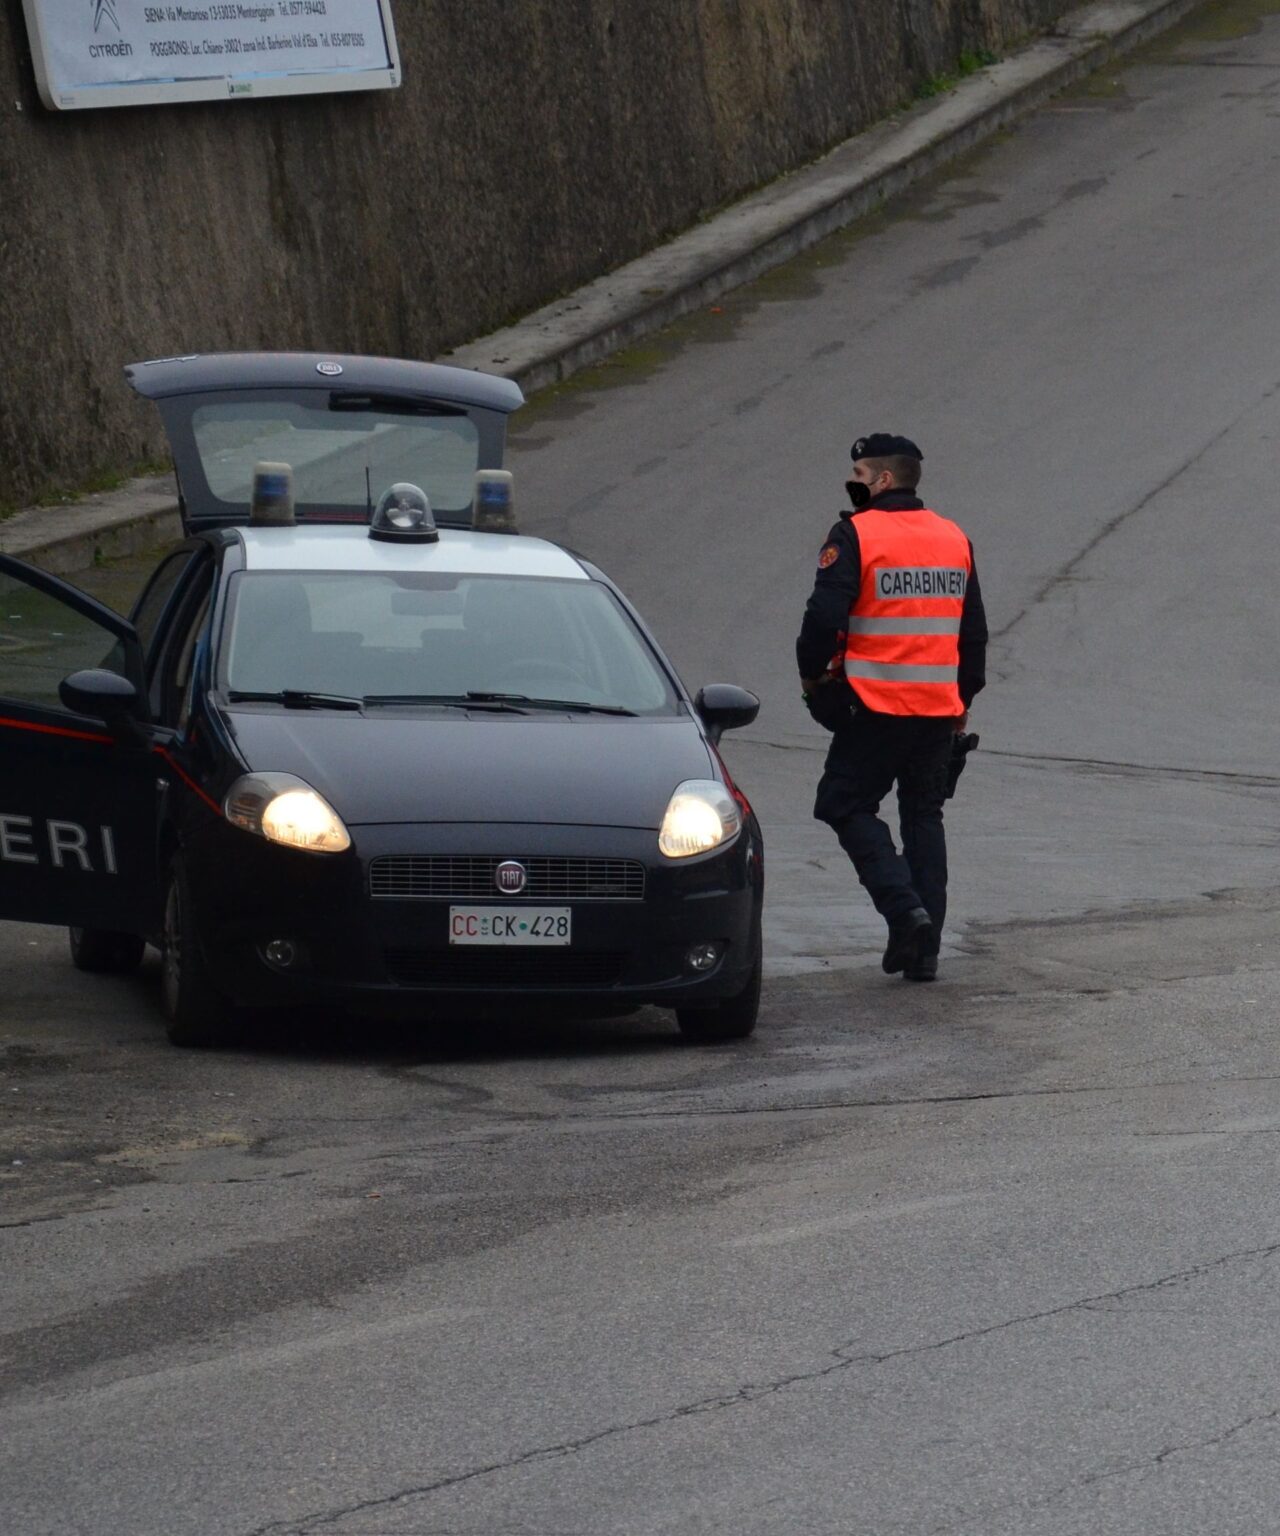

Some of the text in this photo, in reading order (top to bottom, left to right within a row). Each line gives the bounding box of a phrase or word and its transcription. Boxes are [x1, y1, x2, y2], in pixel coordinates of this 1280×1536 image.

[165, 7, 176, 20] Via
[881, 571, 965, 594] CARABINIERI
[501, 870, 520, 886] FIAT
